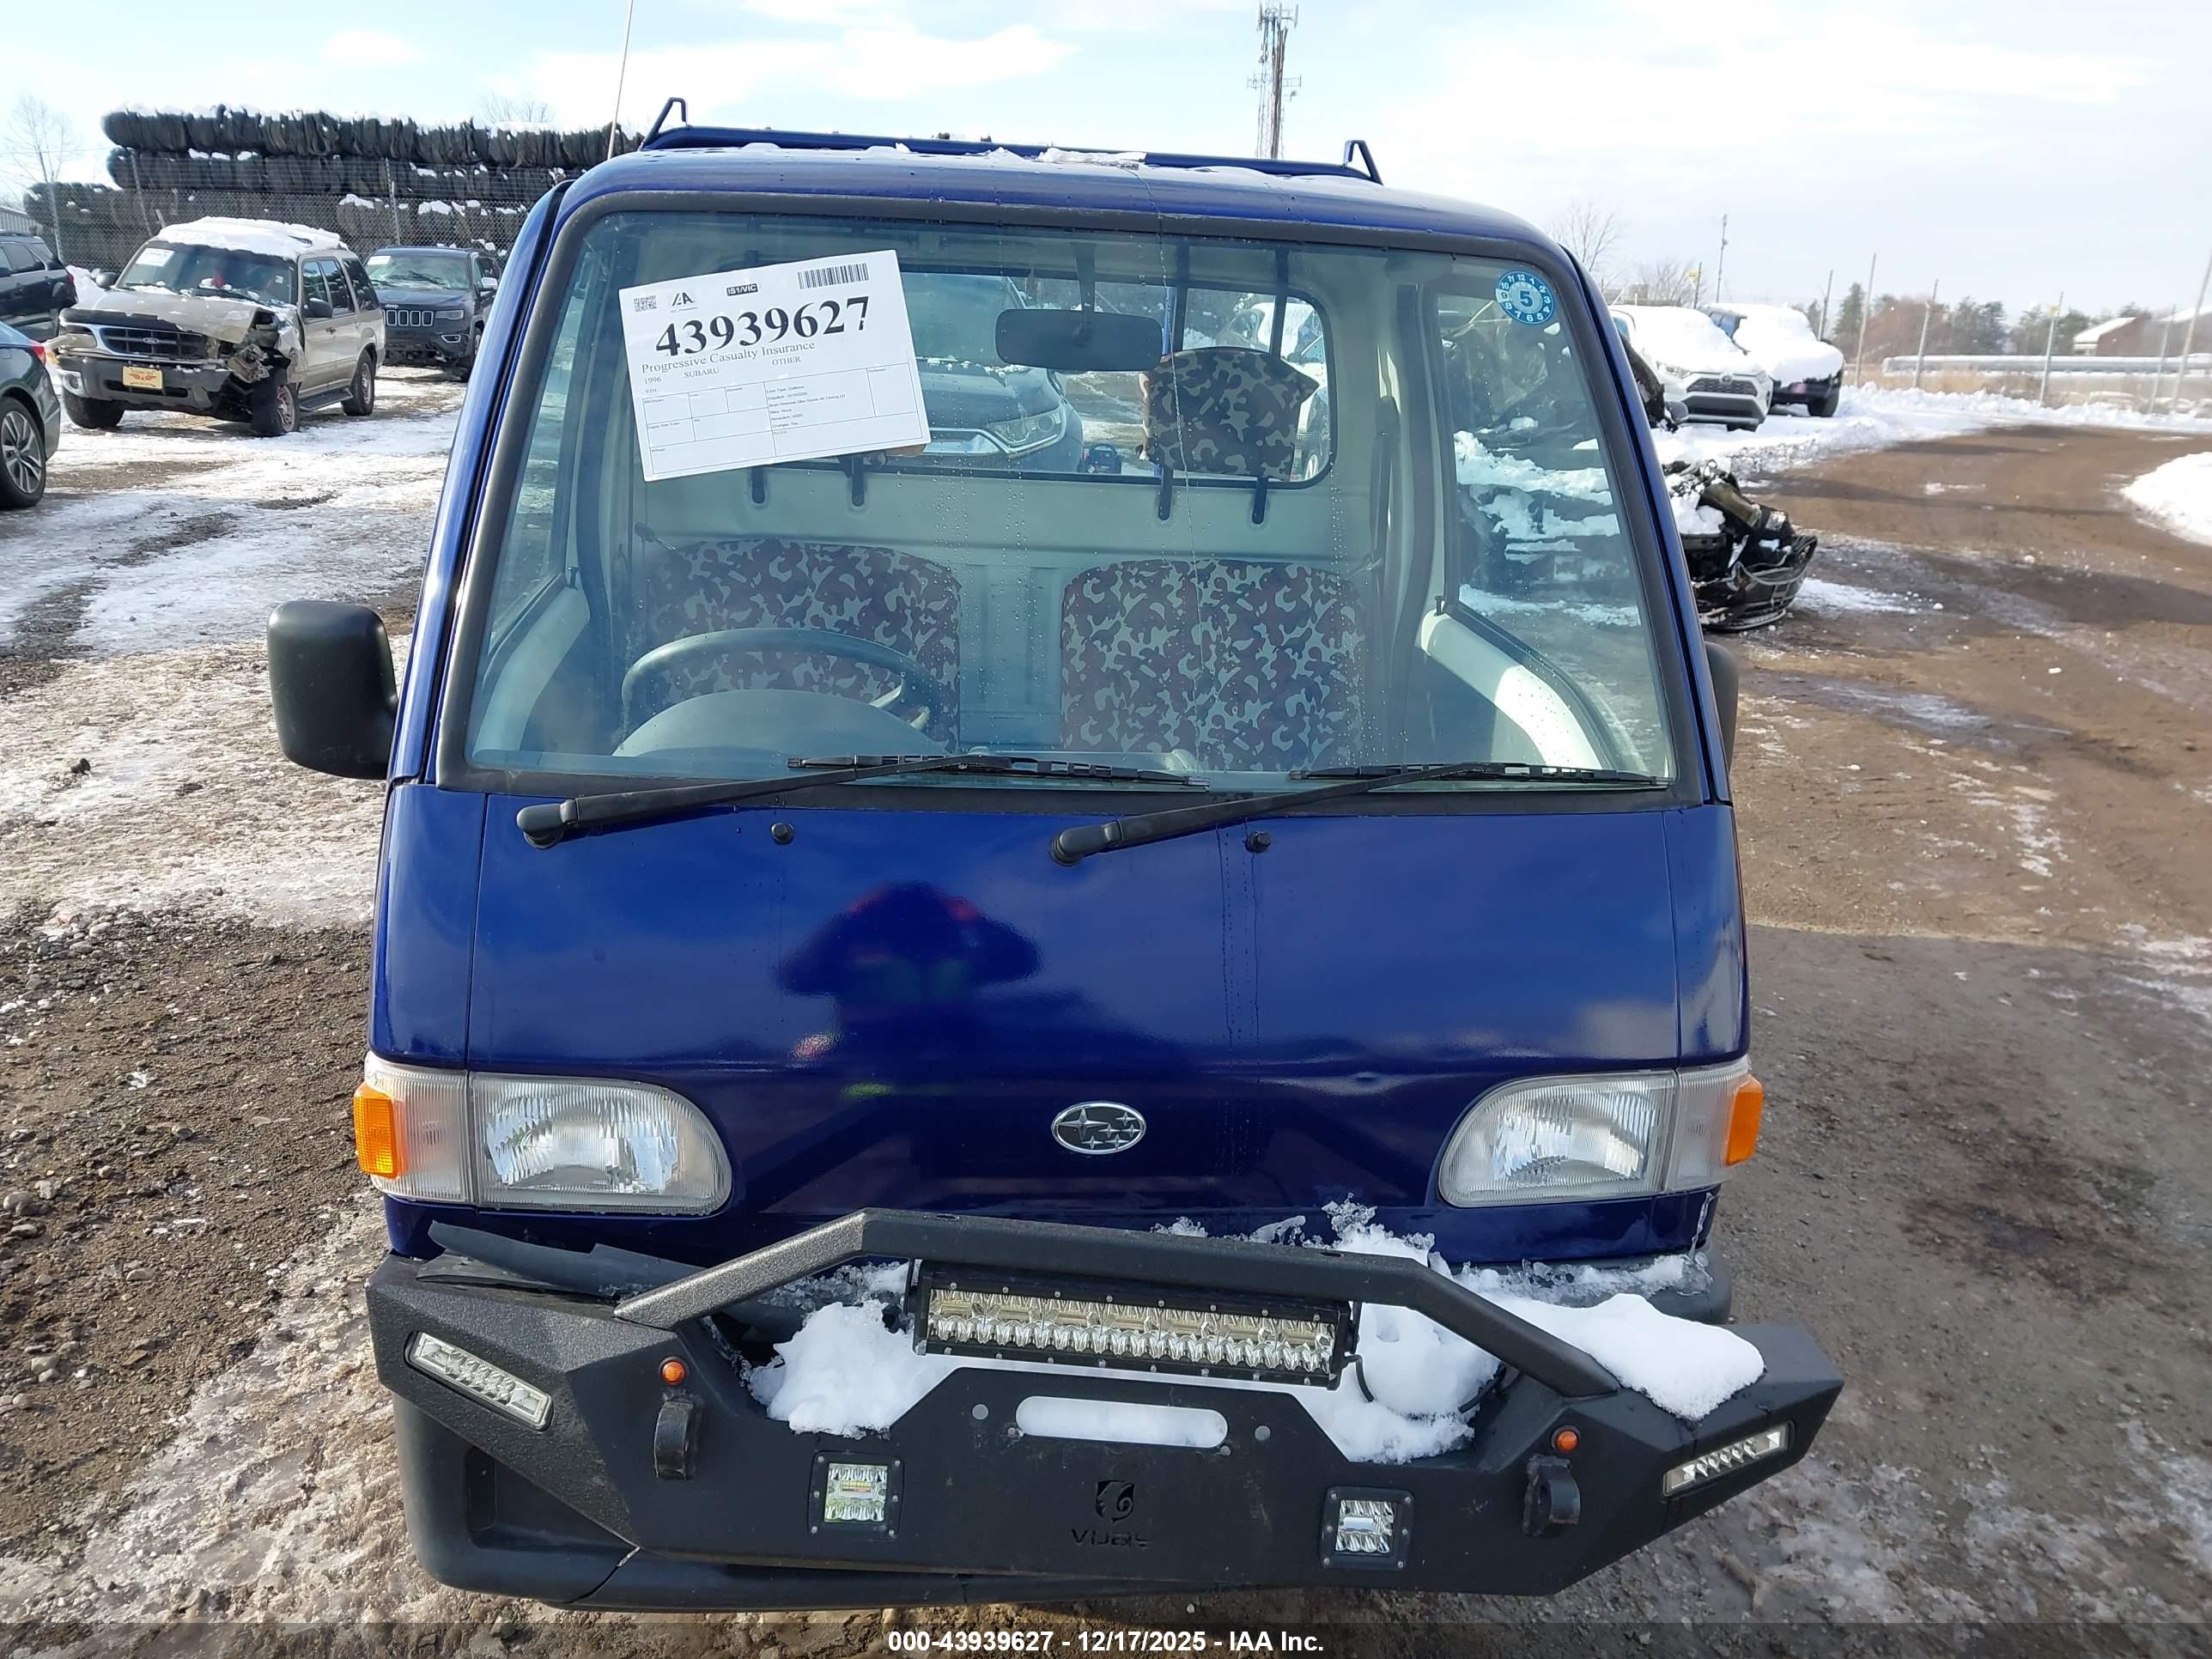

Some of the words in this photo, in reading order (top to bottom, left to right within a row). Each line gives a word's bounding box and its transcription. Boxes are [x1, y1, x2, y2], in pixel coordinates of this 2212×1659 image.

[1501, 282, 1510, 290] 10
[1520, 290, 1533, 307] 5
[655, 296, 869, 356] 43939627
[641, 356, 707, 374] Progressive
[709, 348, 758, 363] Casualty
[763, 341, 816, 356] Insurance
[644, 376, 662, 385] 1996
[684, 367, 720, 379] SUBARU
[772, 356, 801, 366] OTHER
